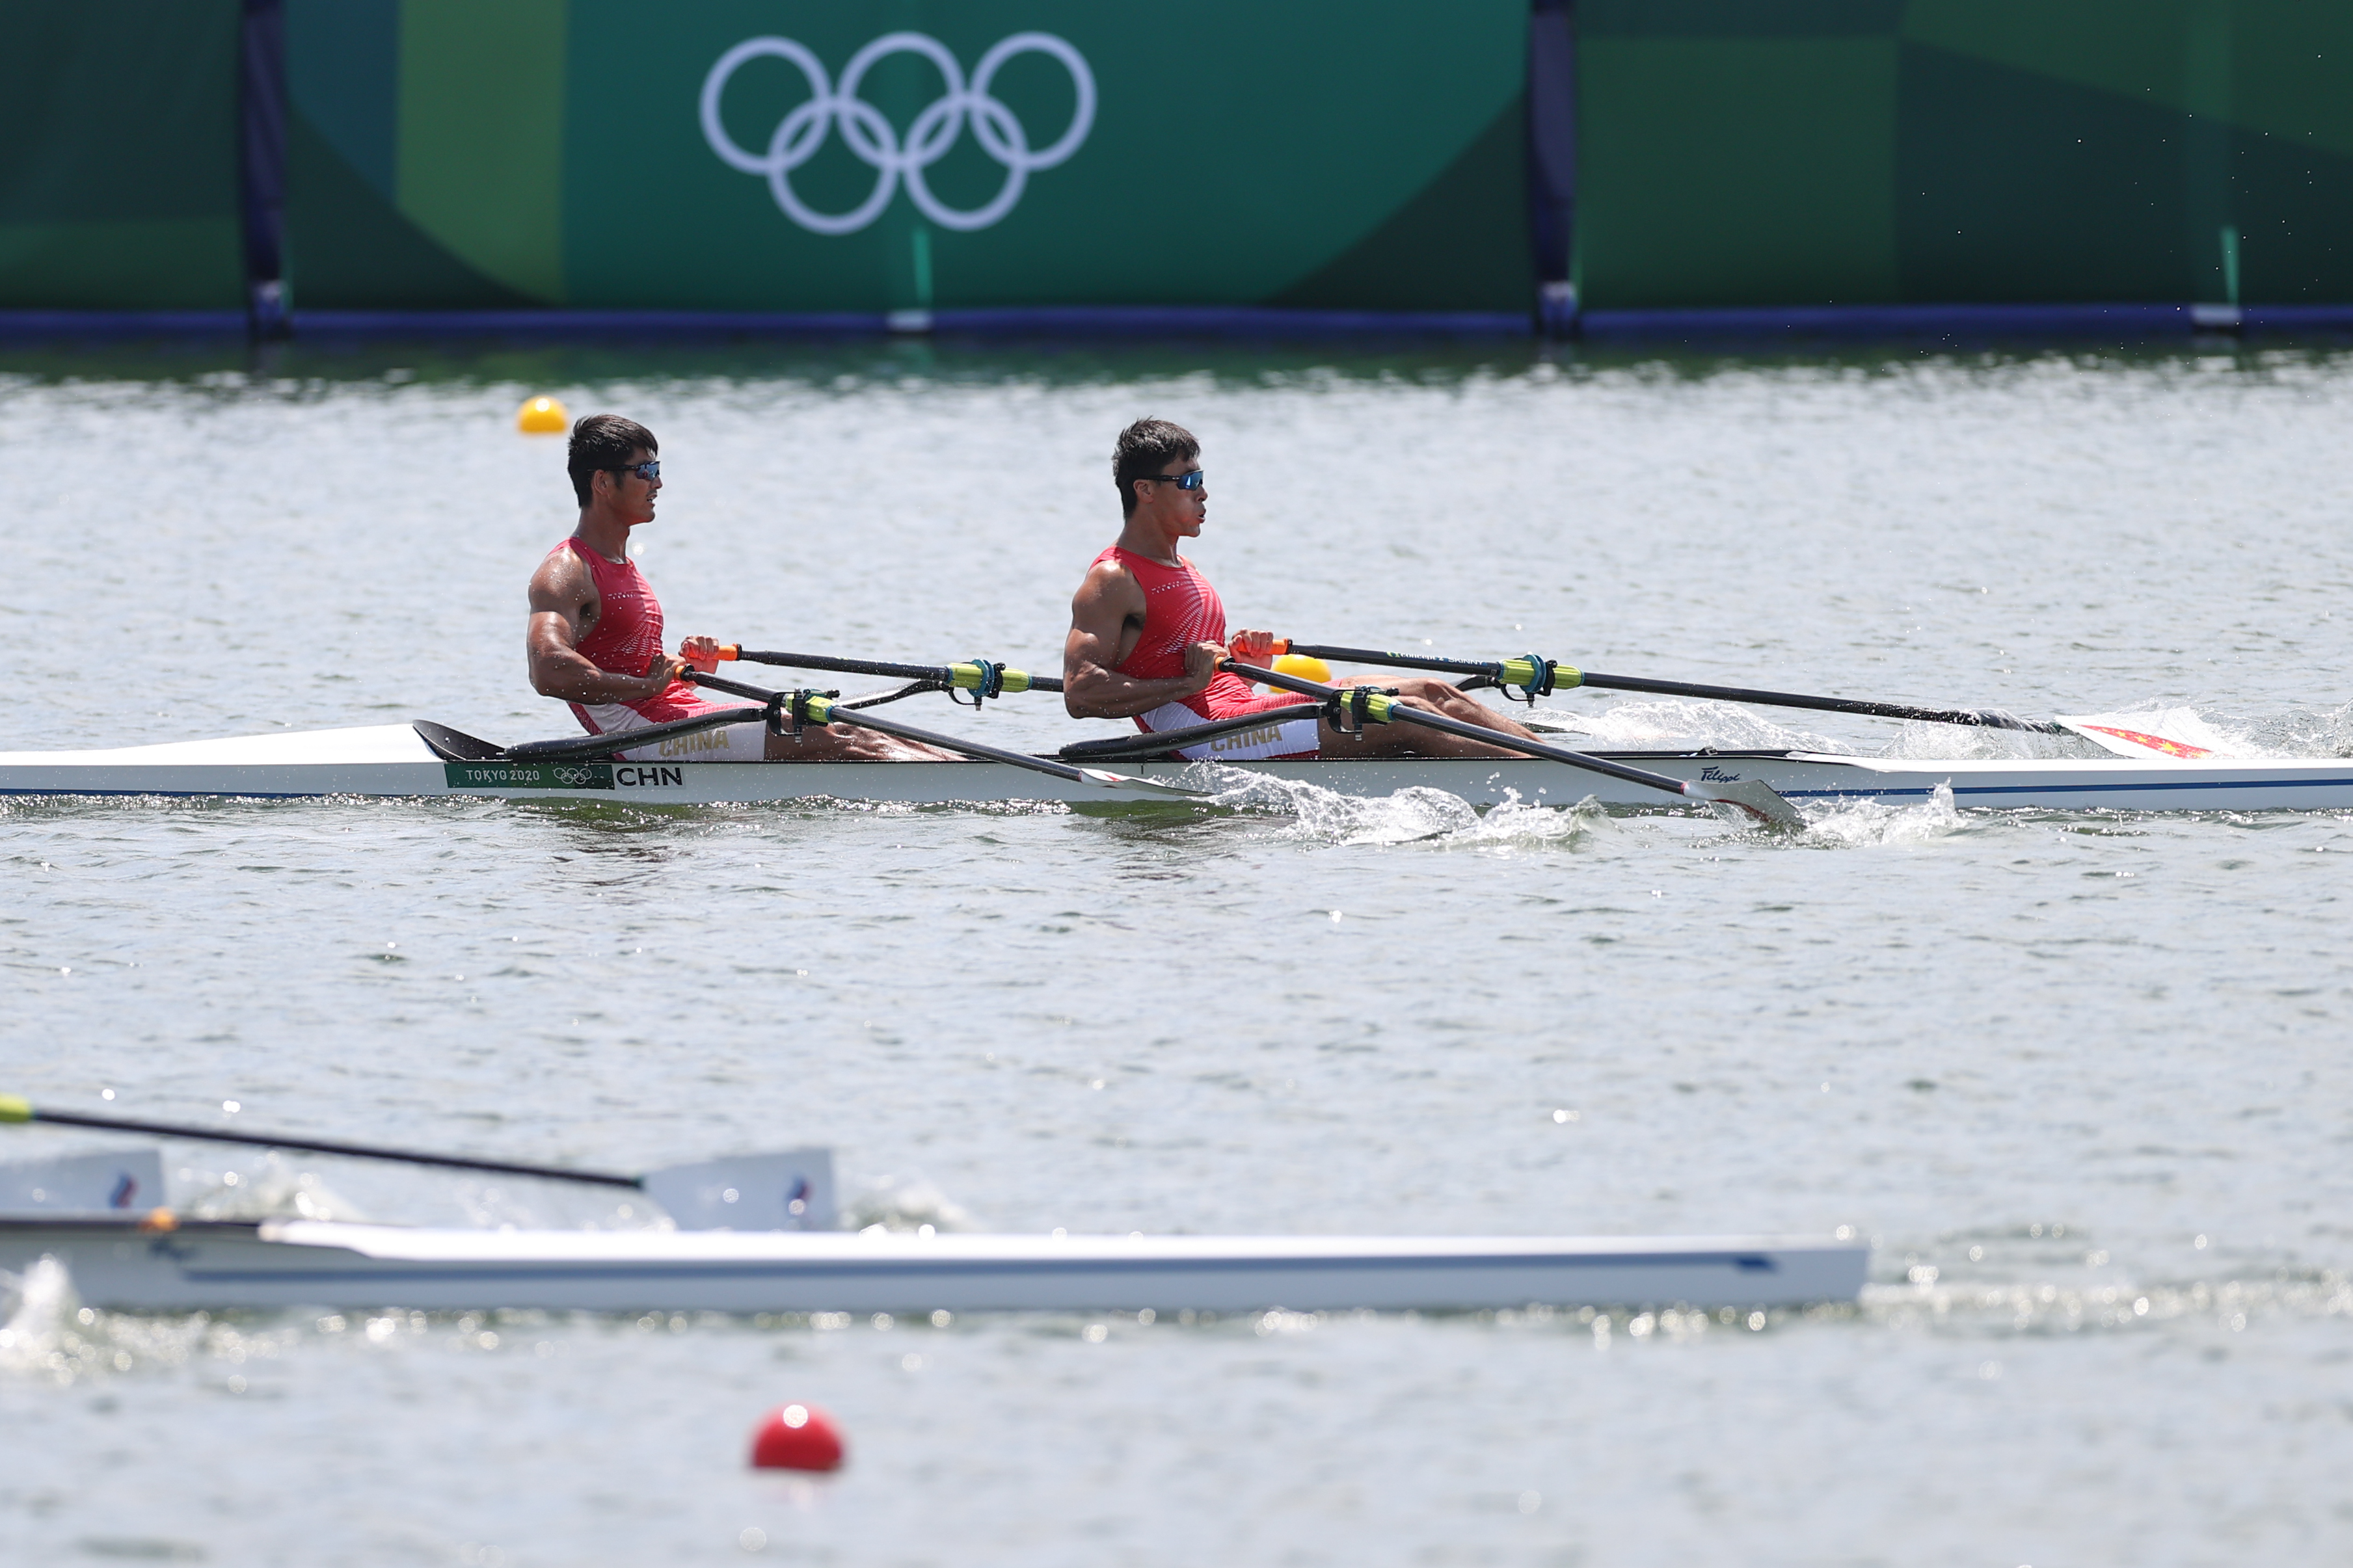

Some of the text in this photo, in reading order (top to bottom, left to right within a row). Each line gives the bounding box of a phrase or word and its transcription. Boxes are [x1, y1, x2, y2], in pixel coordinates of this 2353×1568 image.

[659, 730, 730, 757] CHINA
[1211, 726, 1283, 752] CHINA
[466, 769, 540, 781] TOKYO 2020
[616, 767, 683, 787] CHN
[1701, 765, 1741, 783] Filippi
